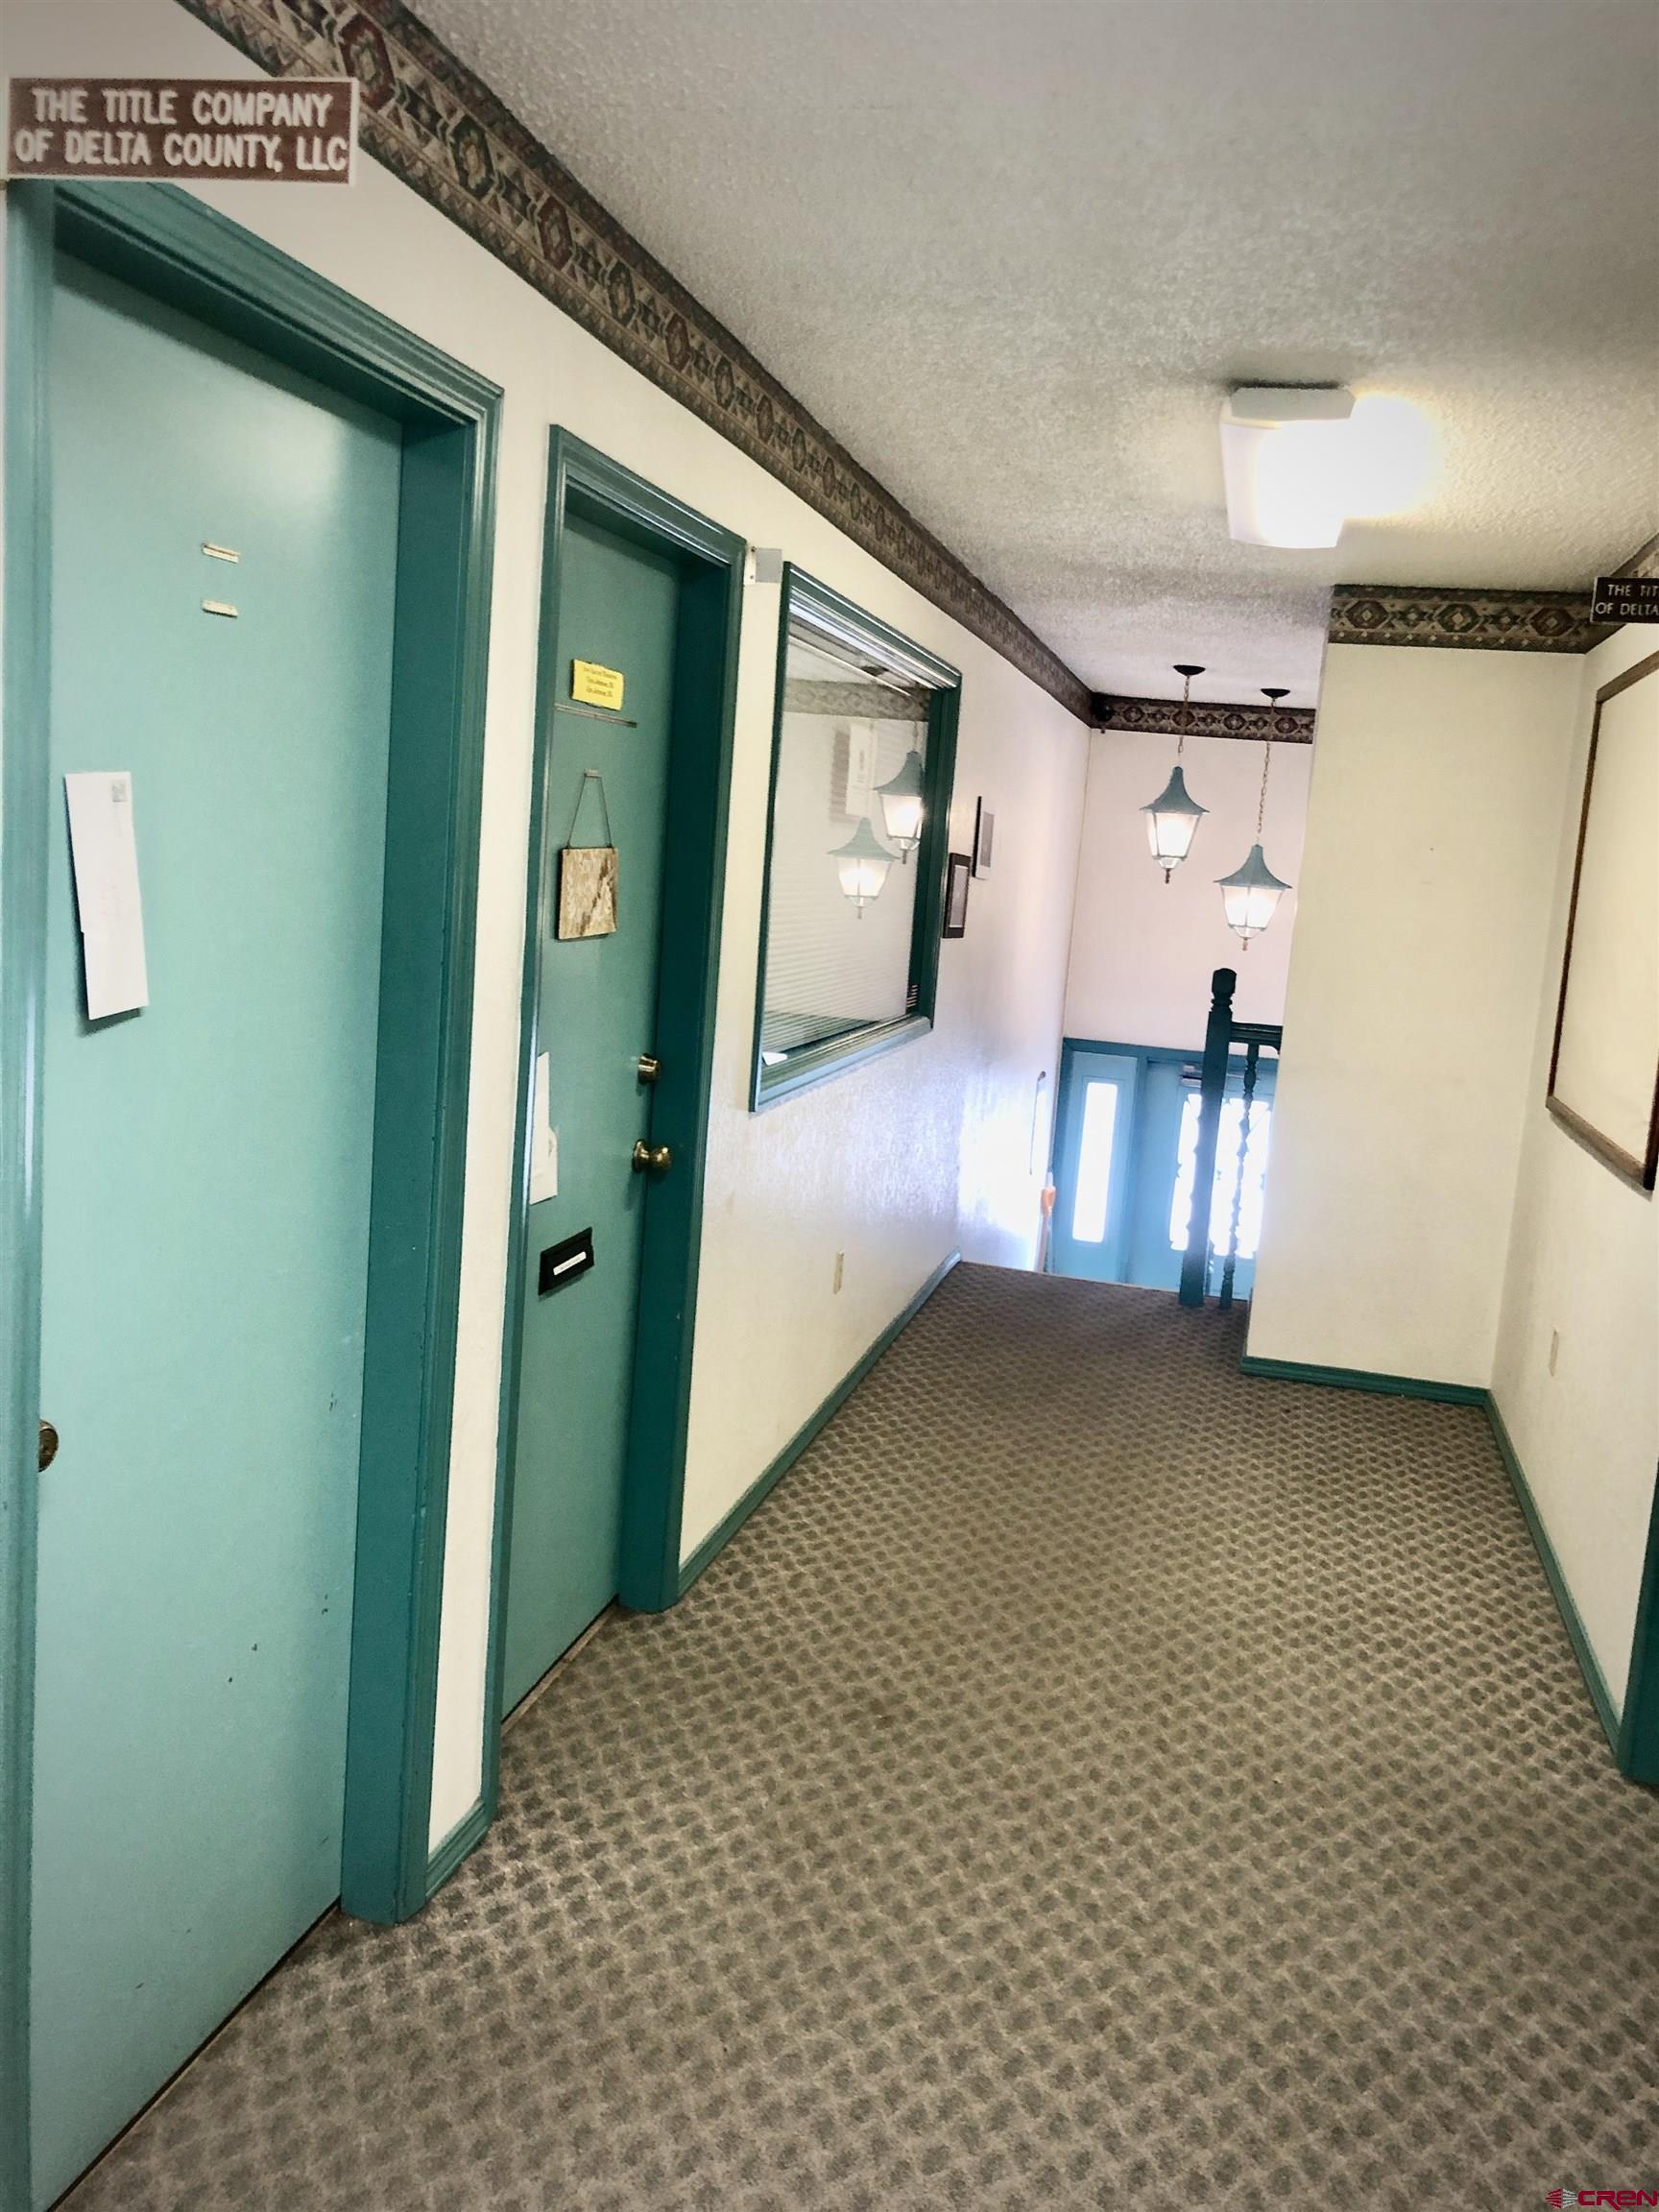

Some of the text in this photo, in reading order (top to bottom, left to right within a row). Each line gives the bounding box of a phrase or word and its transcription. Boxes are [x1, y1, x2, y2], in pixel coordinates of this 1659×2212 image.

[32, 87, 333, 128] THE TITLE COMPANY
[14, 129, 348, 173] OF DELTA COUNTY, LLC
[1607, 584, 1659, 597] THE TIT
[1595, 602, 1659, 615] OF DELTA
